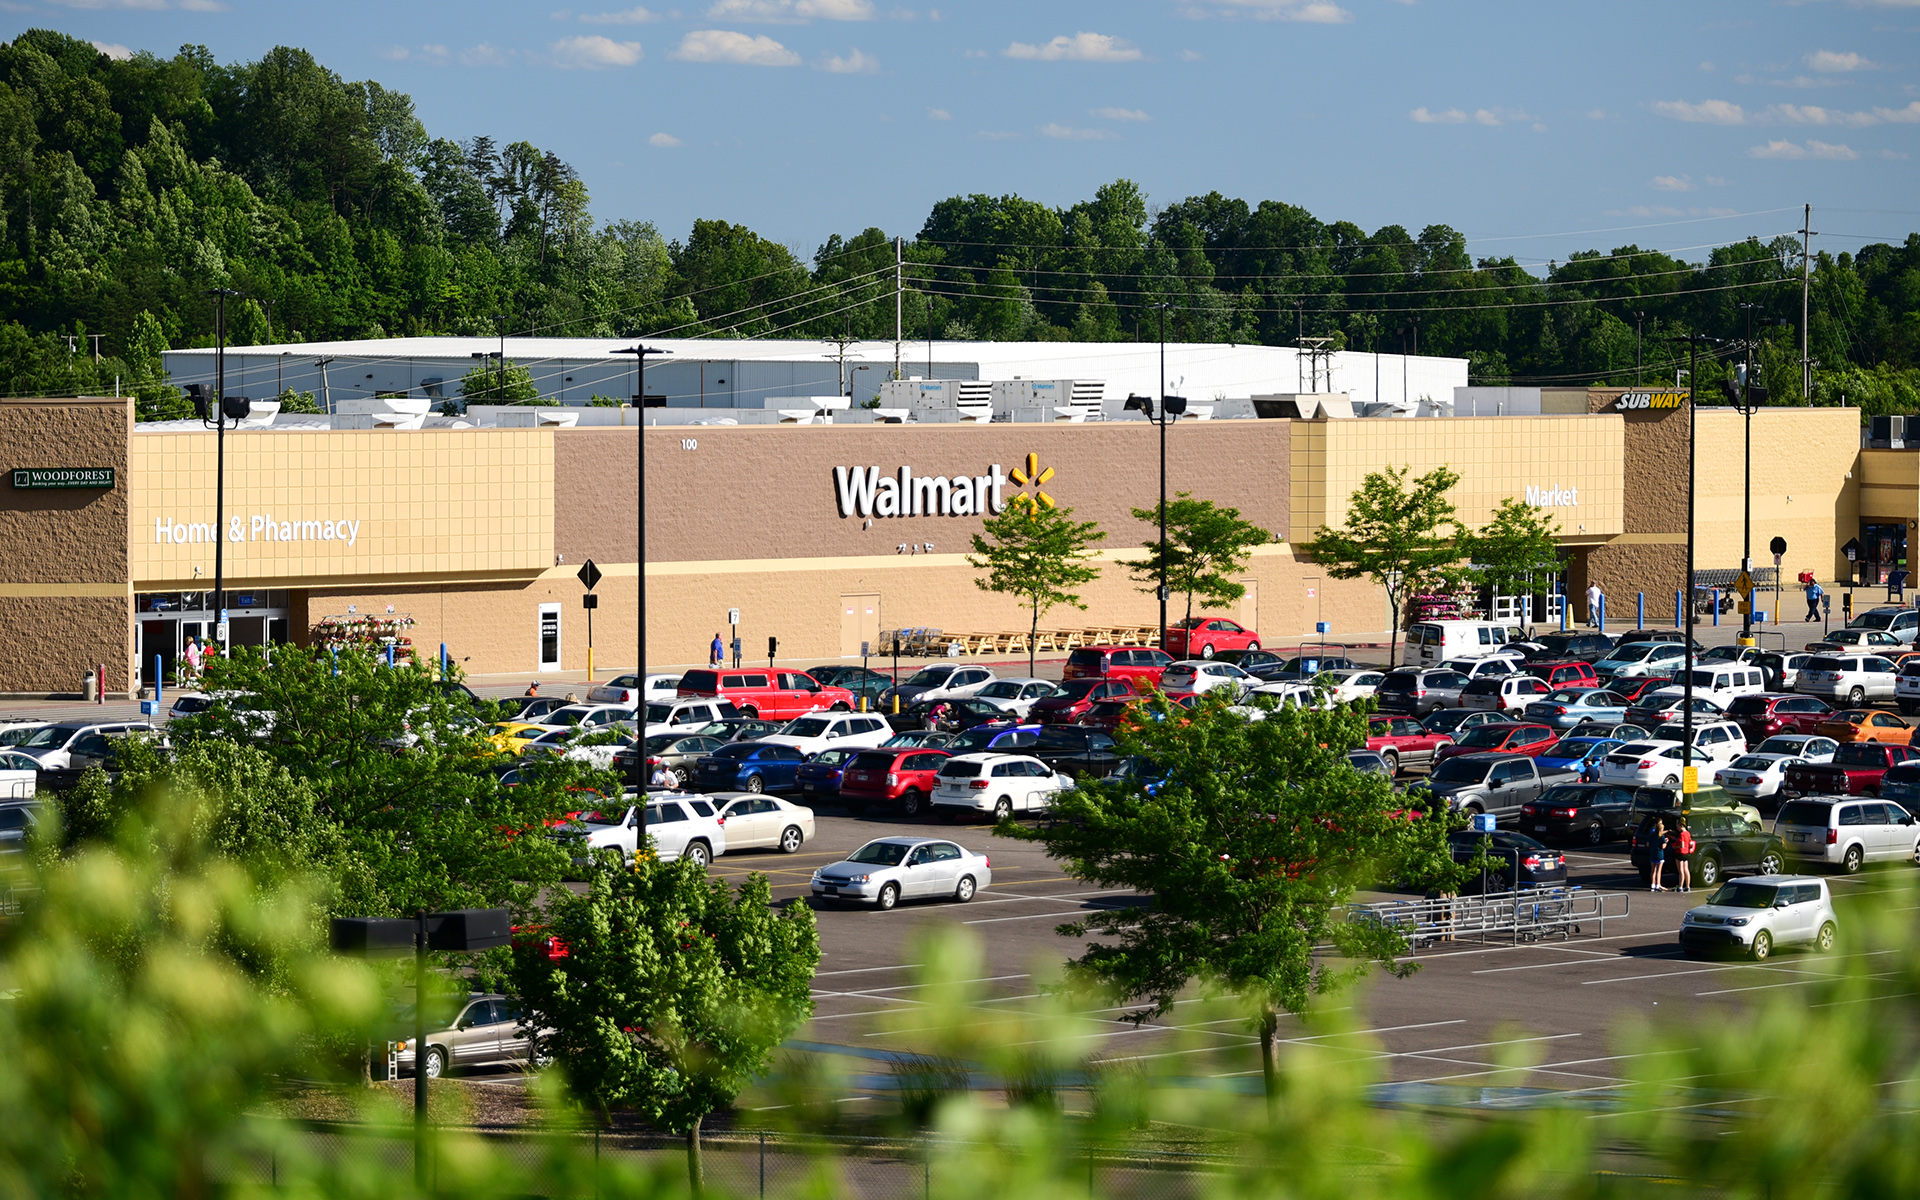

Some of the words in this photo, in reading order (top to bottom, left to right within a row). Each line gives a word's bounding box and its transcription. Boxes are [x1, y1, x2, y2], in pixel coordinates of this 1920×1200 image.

[1615, 391, 1689, 410] SUBWAY
[681, 438, 698, 450] 100
[32, 471, 112, 480] WOODFOREST
[833, 463, 1006, 517] Walmart
[1525, 484, 1578, 507] Market
[155, 516, 217, 544] Home
[228, 515, 245, 543] &
[250, 514, 360, 547] Pharmacy
[218, 630, 223, 638] 8
